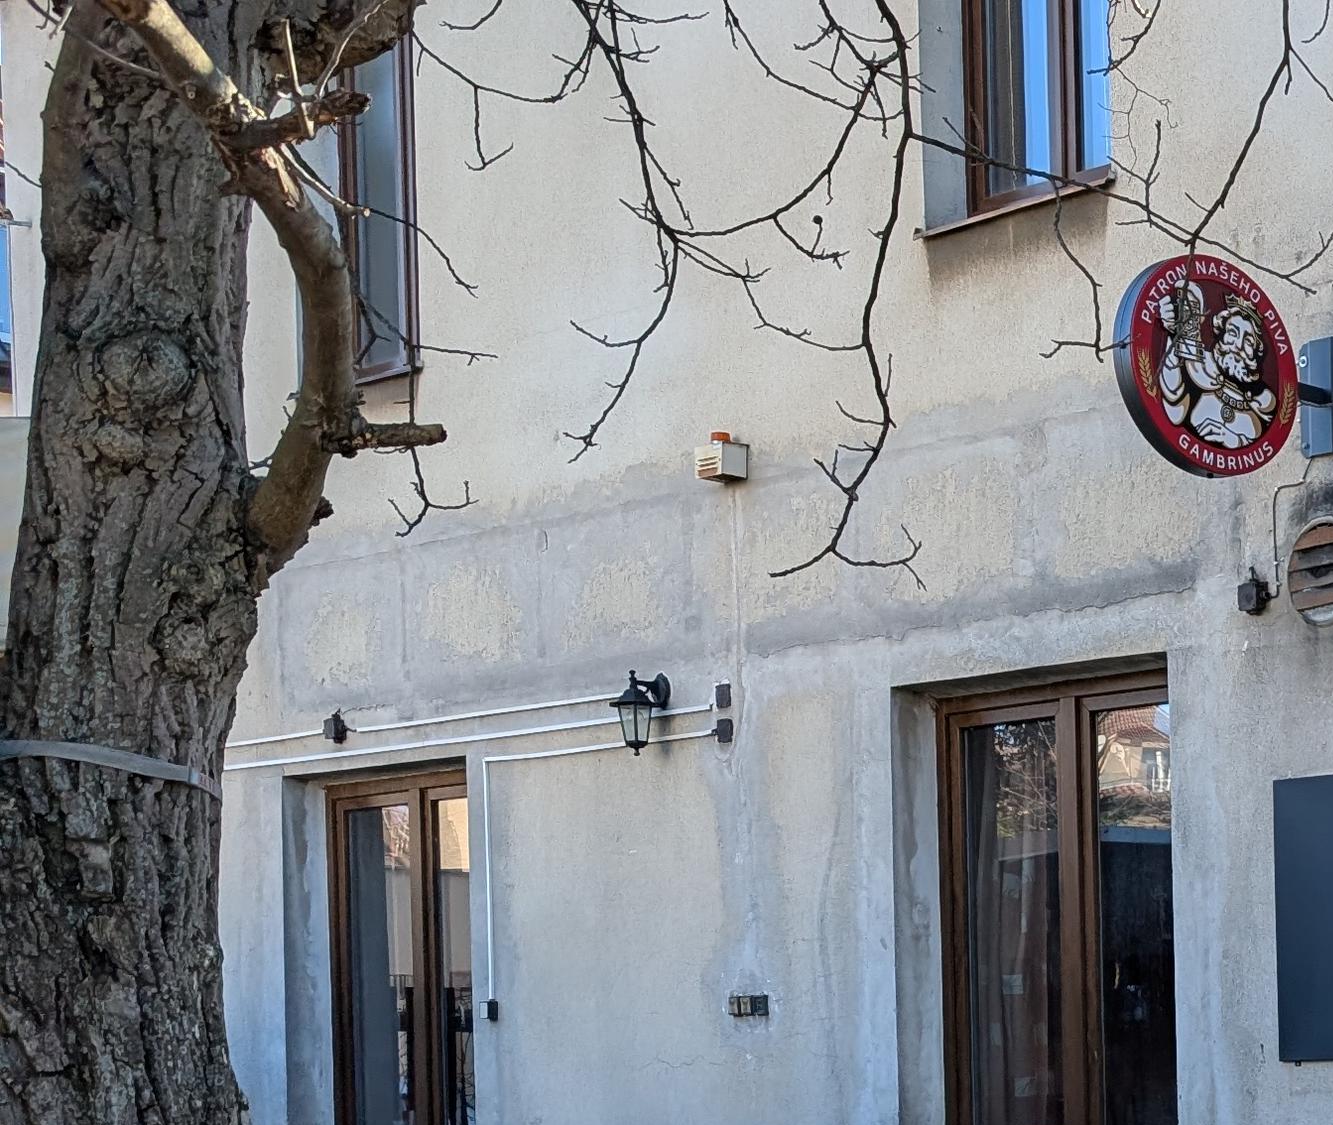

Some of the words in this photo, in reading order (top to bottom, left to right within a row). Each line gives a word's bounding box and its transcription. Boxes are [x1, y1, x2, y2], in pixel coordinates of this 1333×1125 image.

[1142, 264, 1188, 324] PATRON
[1195, 261, 1261, 304] NAŠEHO
[1264, 309, 1288, 355] PIVA
[1178, 434, 1273, 470] GAMBRINUS
